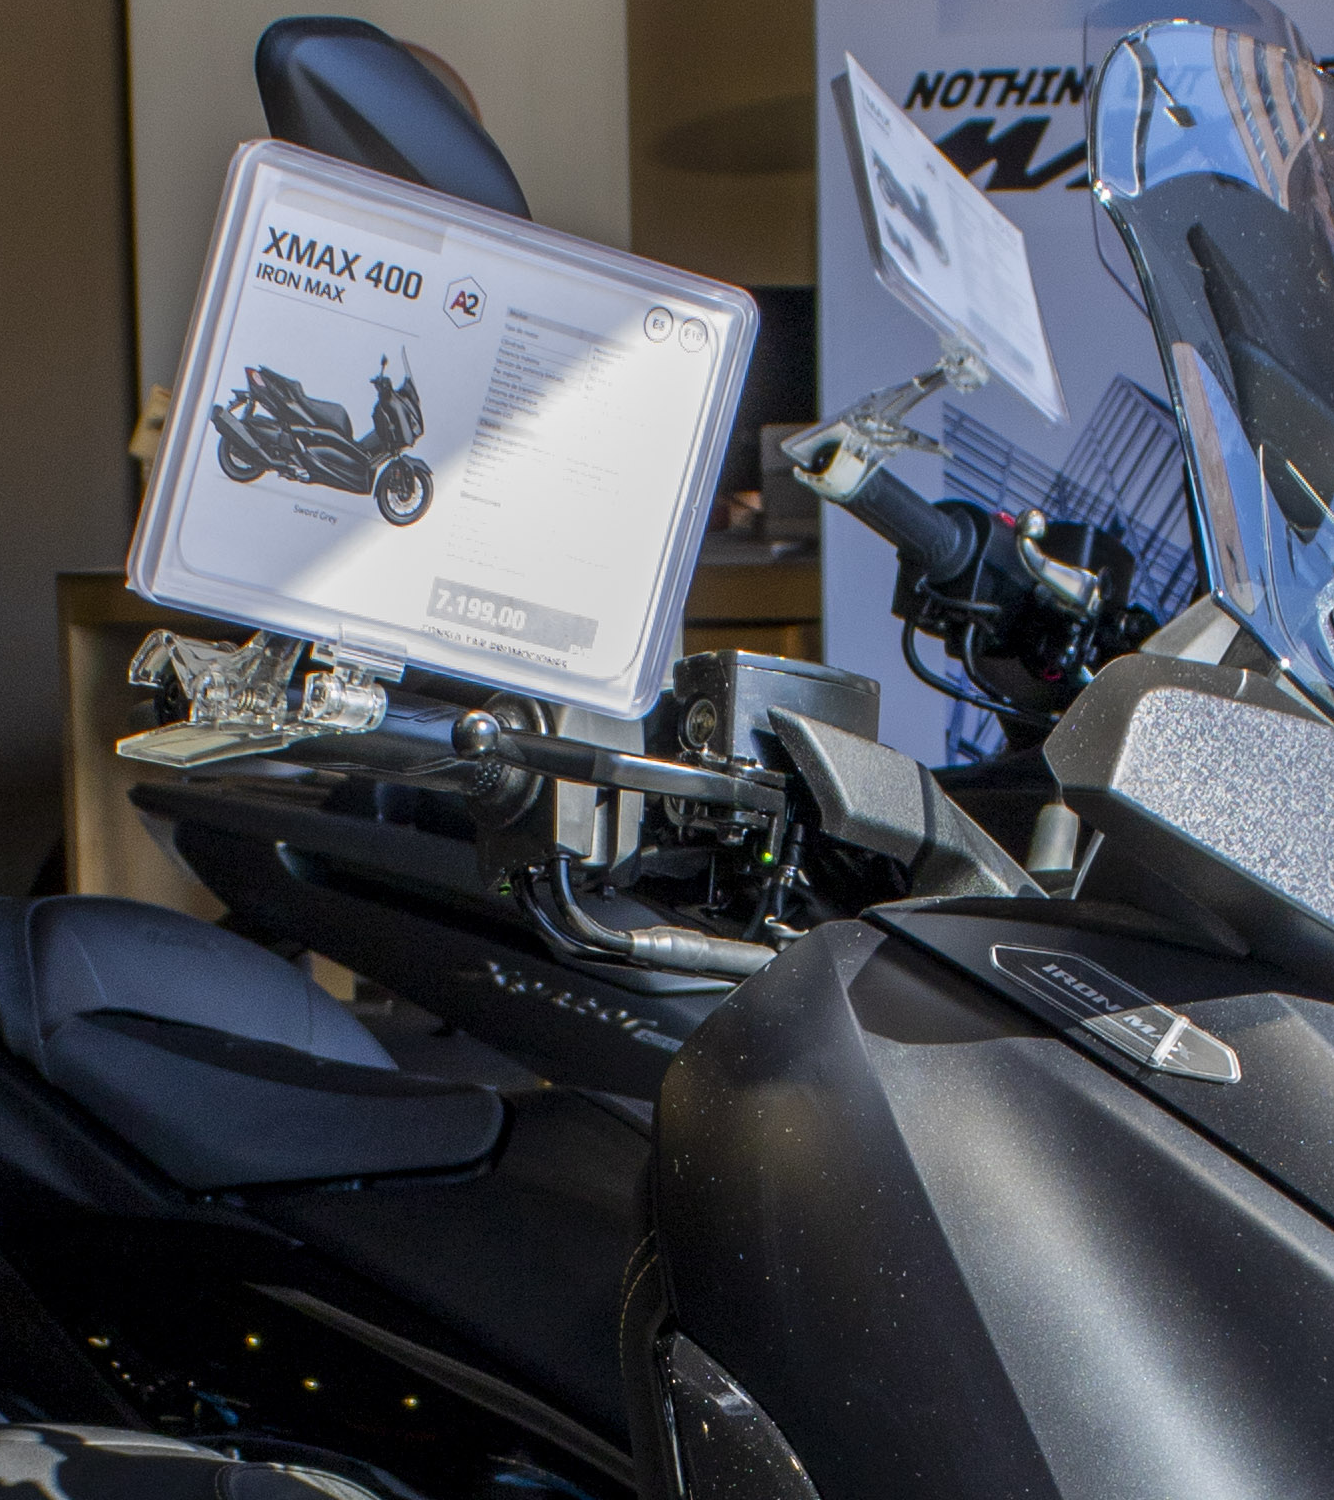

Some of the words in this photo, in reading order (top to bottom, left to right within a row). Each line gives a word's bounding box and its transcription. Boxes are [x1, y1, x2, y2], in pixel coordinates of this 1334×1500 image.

[904, 65, 1095, 111] NOTHIN
[255, 261, 302, 290] IRON
[304, 276, 346, 305] MAX
[261, 225, 363, 283] XMAX
[364, 260, 424, 301] 400
[449, 289, 480, 318] A2
[292, 503, 319, 520] Sword
[319, 509, 339, 527] Grey
[435, 587, 528, 632] 7.199,00
[1041, 962, 1125, 1013] IRON
